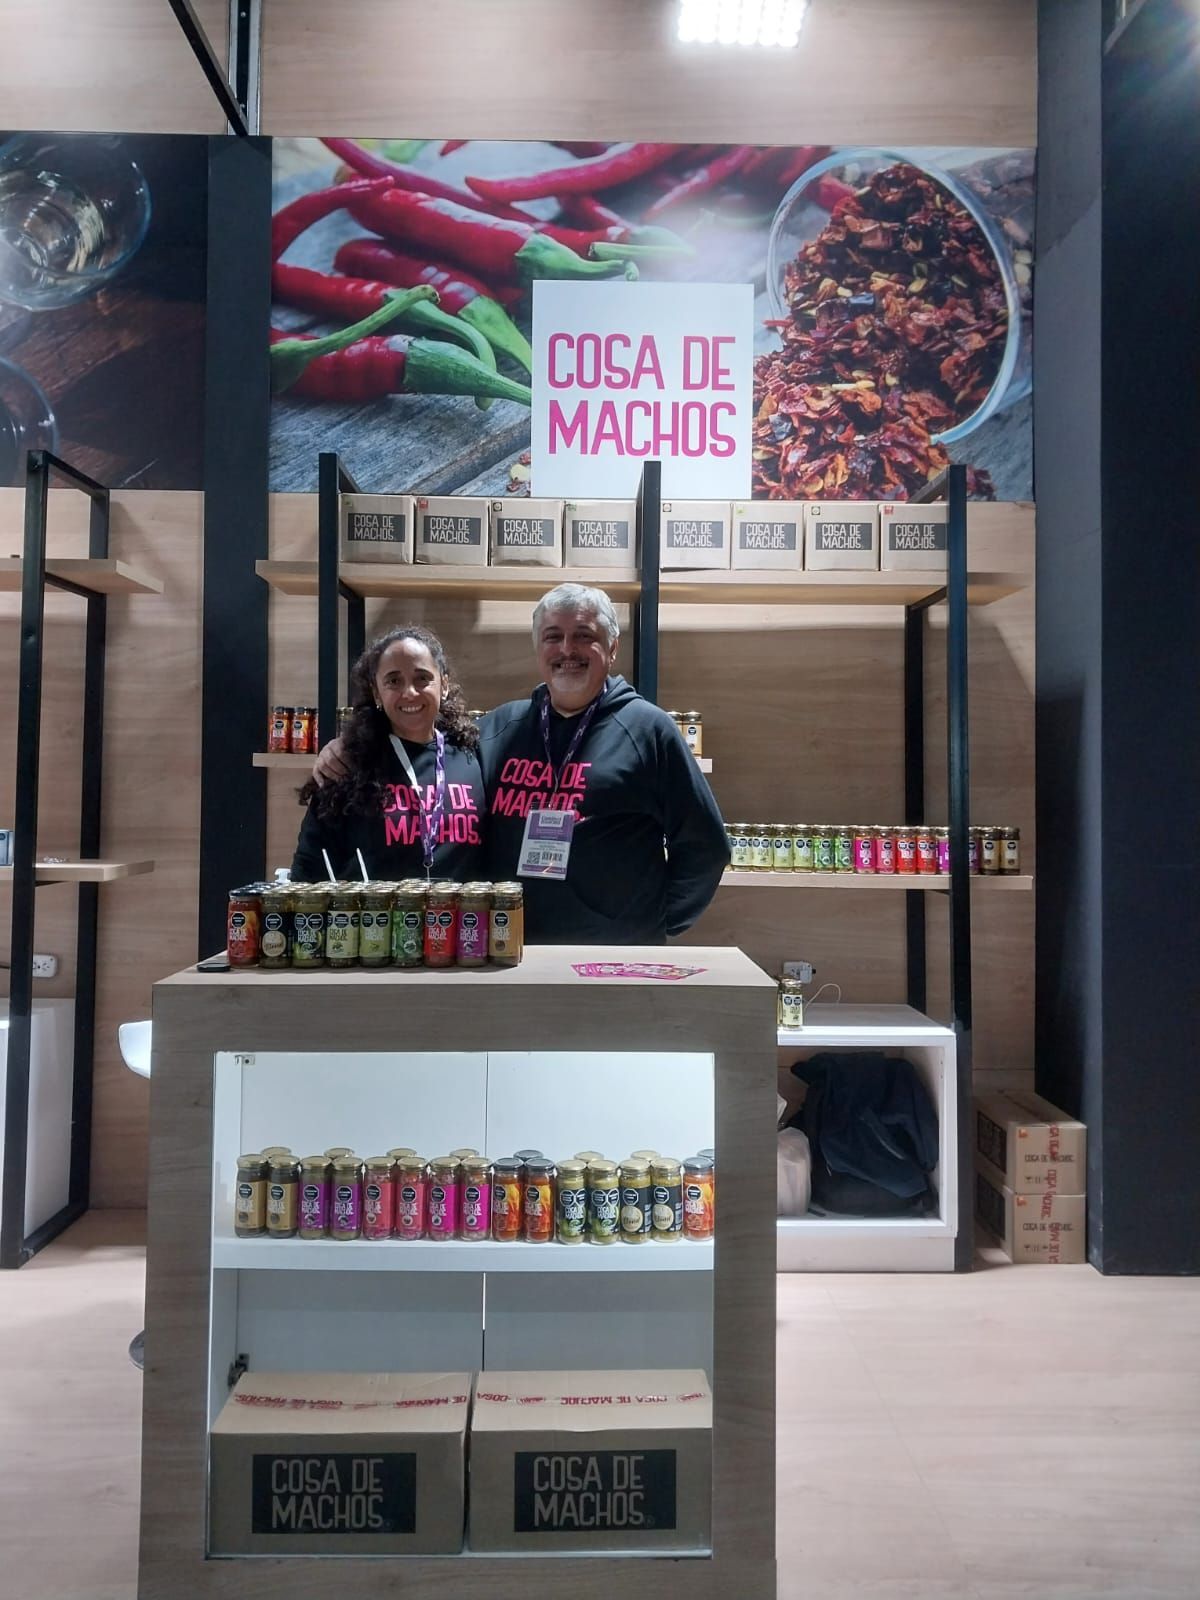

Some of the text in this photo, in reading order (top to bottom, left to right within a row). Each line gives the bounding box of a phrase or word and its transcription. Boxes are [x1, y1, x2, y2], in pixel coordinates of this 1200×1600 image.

[548, 332, 736, 391] COSA DE
[548, 399, 737, 458] MACHOS
[354, 514, 395, 529] COSA DE
[430, 516, 470, 531] COSA DE
[503, 519, 543, 533] COSA DE
[578, 521, 617, 535] COSA DE
[673, 522, 713, 535] COSA DE
[354, 528, 394, 541] MACHOS
[430, 530, 470, 544] MACHOS
[746, 524, 785, 537] COSA DE
[822, 524, 861, 537] COSA DE
[895, 524, 935, 537] COSA DE
[503, 532, 544, 545] MACHOS
[578, 534, 617, 547] MACHOS
[673, 534, 713, 548] MACHOS
[746, 536, 785, 549] MACHOS
[822, 537, 862, 550] MACHOS
[895, 537, 936, 550] MACHOS
[500, 758, 592, 789] COSA DE
[448, 783, 477, 811] DE
[272, 1459, 384, 1494] COSA DE
[534, 1455, 644, 1491] COSA DE
[272, 1495, 384, 1529] MACHOS
[534, 1492, 644, 1527] MACHOS
